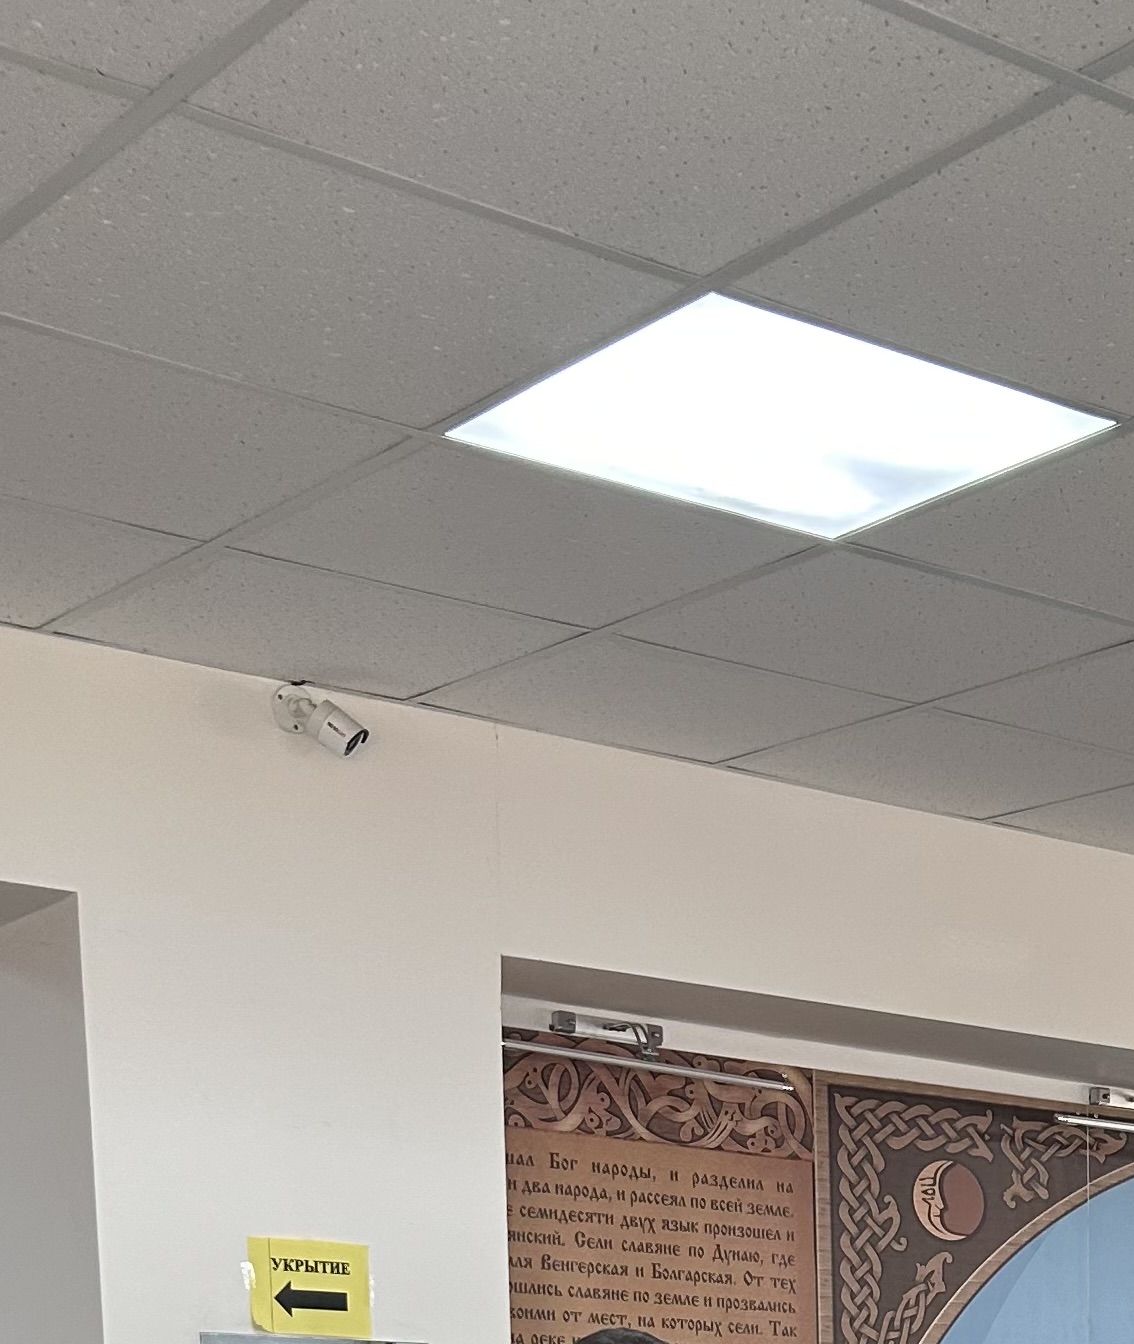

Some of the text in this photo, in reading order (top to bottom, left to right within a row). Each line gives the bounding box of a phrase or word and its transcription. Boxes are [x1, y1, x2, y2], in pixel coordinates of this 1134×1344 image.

[549, 1152, 578, 1171] Бог
[592, 1161, 656, 1182] народы,
[670, 1170, 678, 1182] и
[692, 1172, 764, 1190] разделил
[776, 1181, 794, 1194] на
[522, 1180, 550, 1196] два
[555, 1183, 613, 1202] народа,
[617, 1190, 626, 1202] и
[630, 1190, 686, 1208] рассеял
[690, 1197, 706, 1210] по
[711, 1198, 743, 1213] всей
[746, 1203, 794, 1219] земле.
[519, 1205, 614, 1225] семидесяти
[620, 1216, 656, 1235] двух
[661, 1218, 699, 1234] язык
[704, 1223, 781, 1241] произошел
[787, 1230, 795, 1242] и
[270, 1257, 351, 1276] УКРЫТИЕ
[574, 1231, 613, 1250] Сели
[621, 1239, 681, 1257] славяне
[688, 1245, 705, 1259] по
[712, 1244, 764, 1266] Дунаю,
[771, 1253, 796, 1269] где
[541, 1253, 629, 1278] Венгерская
[635, 1266, 644, 1278] и
[651, 1262, 737, 1286] Болгарская.
[743, 1270, 765, 1288] От
[770, 1276, 797, 1294] тех
[568, 1285, 629, 1301] славяне
[634, 1290, 650, 1304] по
[653, 1292, 700, 1308] земле
[704, 1296, 712, 1308] и
[716, 1297, 797, 1314] прозвались
[562, 1310, 582, 1323] от
[587, 1313, 632, 1329] мест,
[638, 1316, 655, 1328] на
[661, 1317, 722, 1338] которых
[728, 1321, 764, 1336] сели.
[769, 1320, 797, 1338] Так
